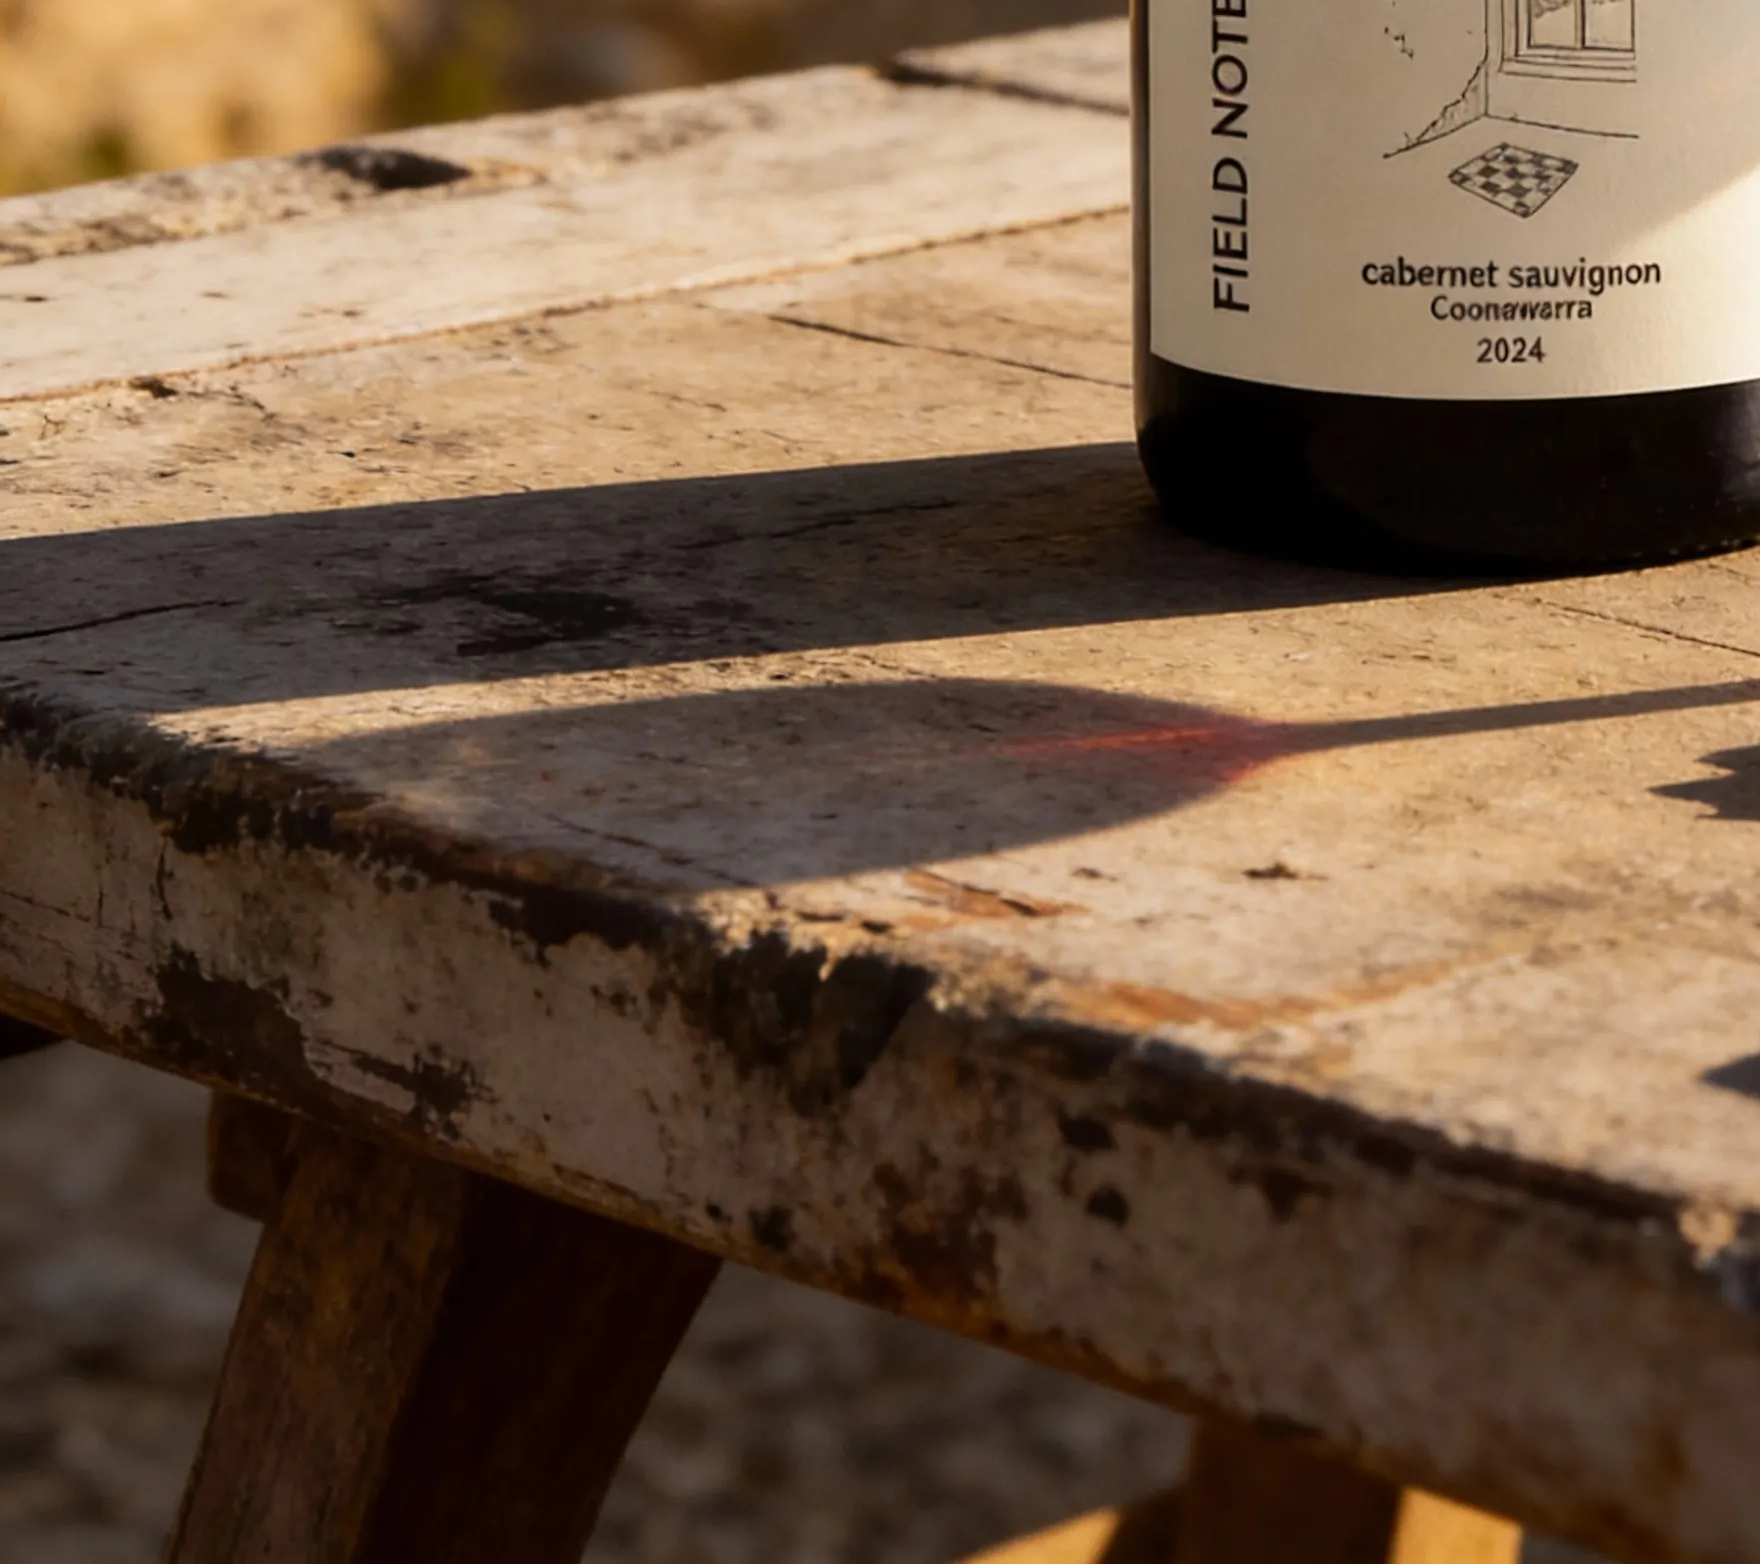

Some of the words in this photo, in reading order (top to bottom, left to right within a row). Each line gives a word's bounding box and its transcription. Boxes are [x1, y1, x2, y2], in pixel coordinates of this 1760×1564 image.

[1211, 156, 1250, 313] FIELD
[1361, 256, 1499, 288] cabernet
[1508, 257, 1661, 296] sauvignon
[1430, 294, 1593, 321] Coonawarra
[1477, 336, 1547, 363] 2024
